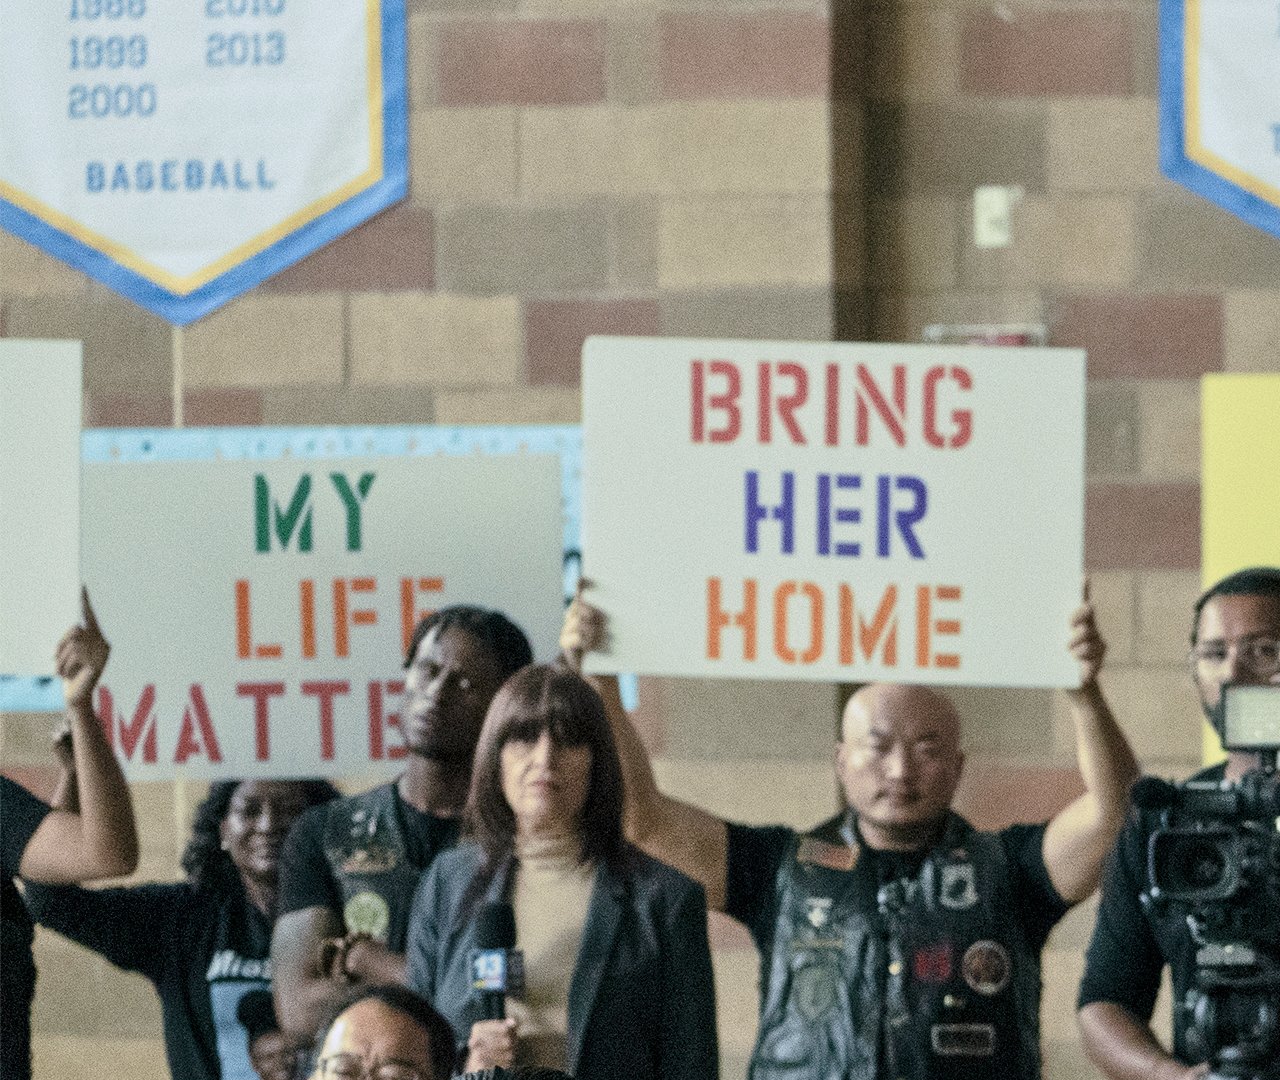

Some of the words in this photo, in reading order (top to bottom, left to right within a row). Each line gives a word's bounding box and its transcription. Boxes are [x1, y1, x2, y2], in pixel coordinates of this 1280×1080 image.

[204, 31, 287, 68] 2013
[67, 83, 158, 119] 2000
[85, 158, 277, 194] BASEBALL
[690, 360, 974, 450] BRING
[254, 472, 377, 554] MY
[743, 470, 929, 560] HER
[705, 576, 962, 670] HOME
[98, 680, 410, 766] MATTE
